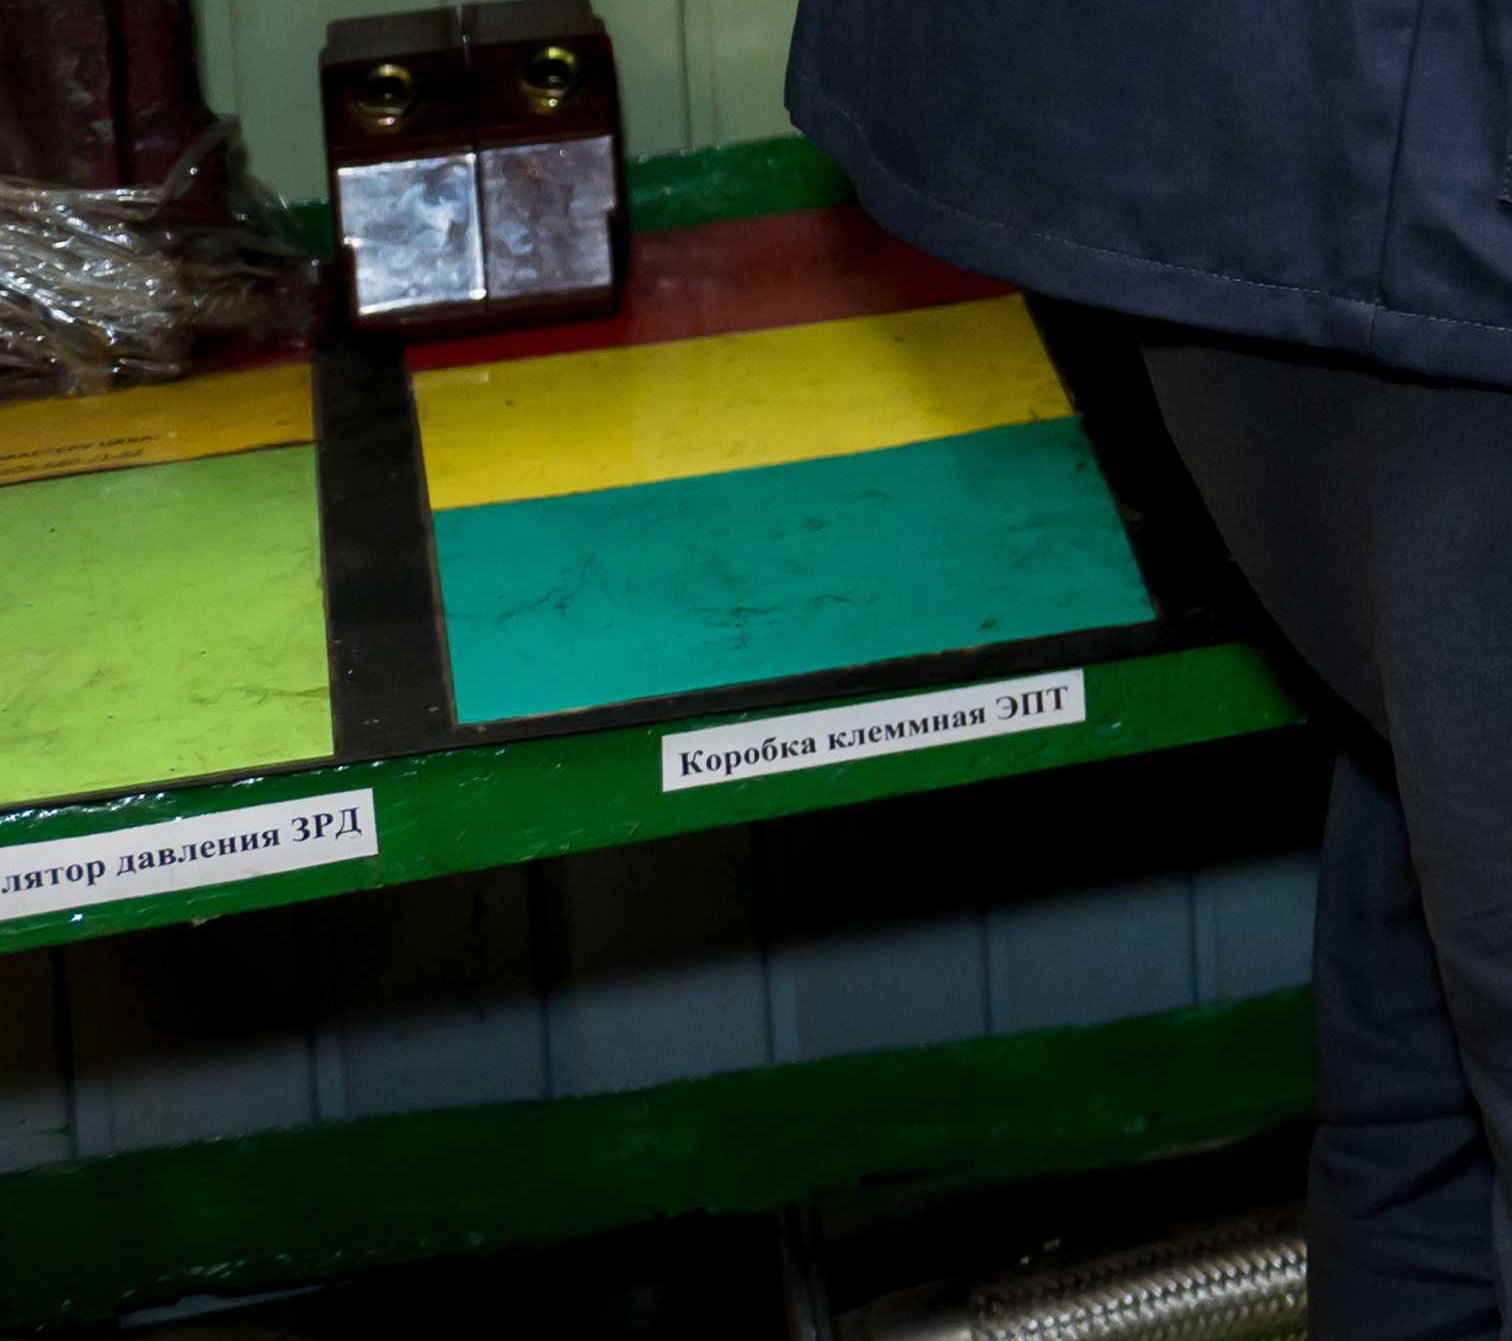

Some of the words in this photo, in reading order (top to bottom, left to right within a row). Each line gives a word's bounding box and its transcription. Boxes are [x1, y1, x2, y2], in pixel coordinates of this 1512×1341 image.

[678, 735, 817, 777] Коробка
[828, 706, 986, 752] клеммная
[995, 685, 1069, 722] ЭПТ
[116, 828, 281, 877] давления
